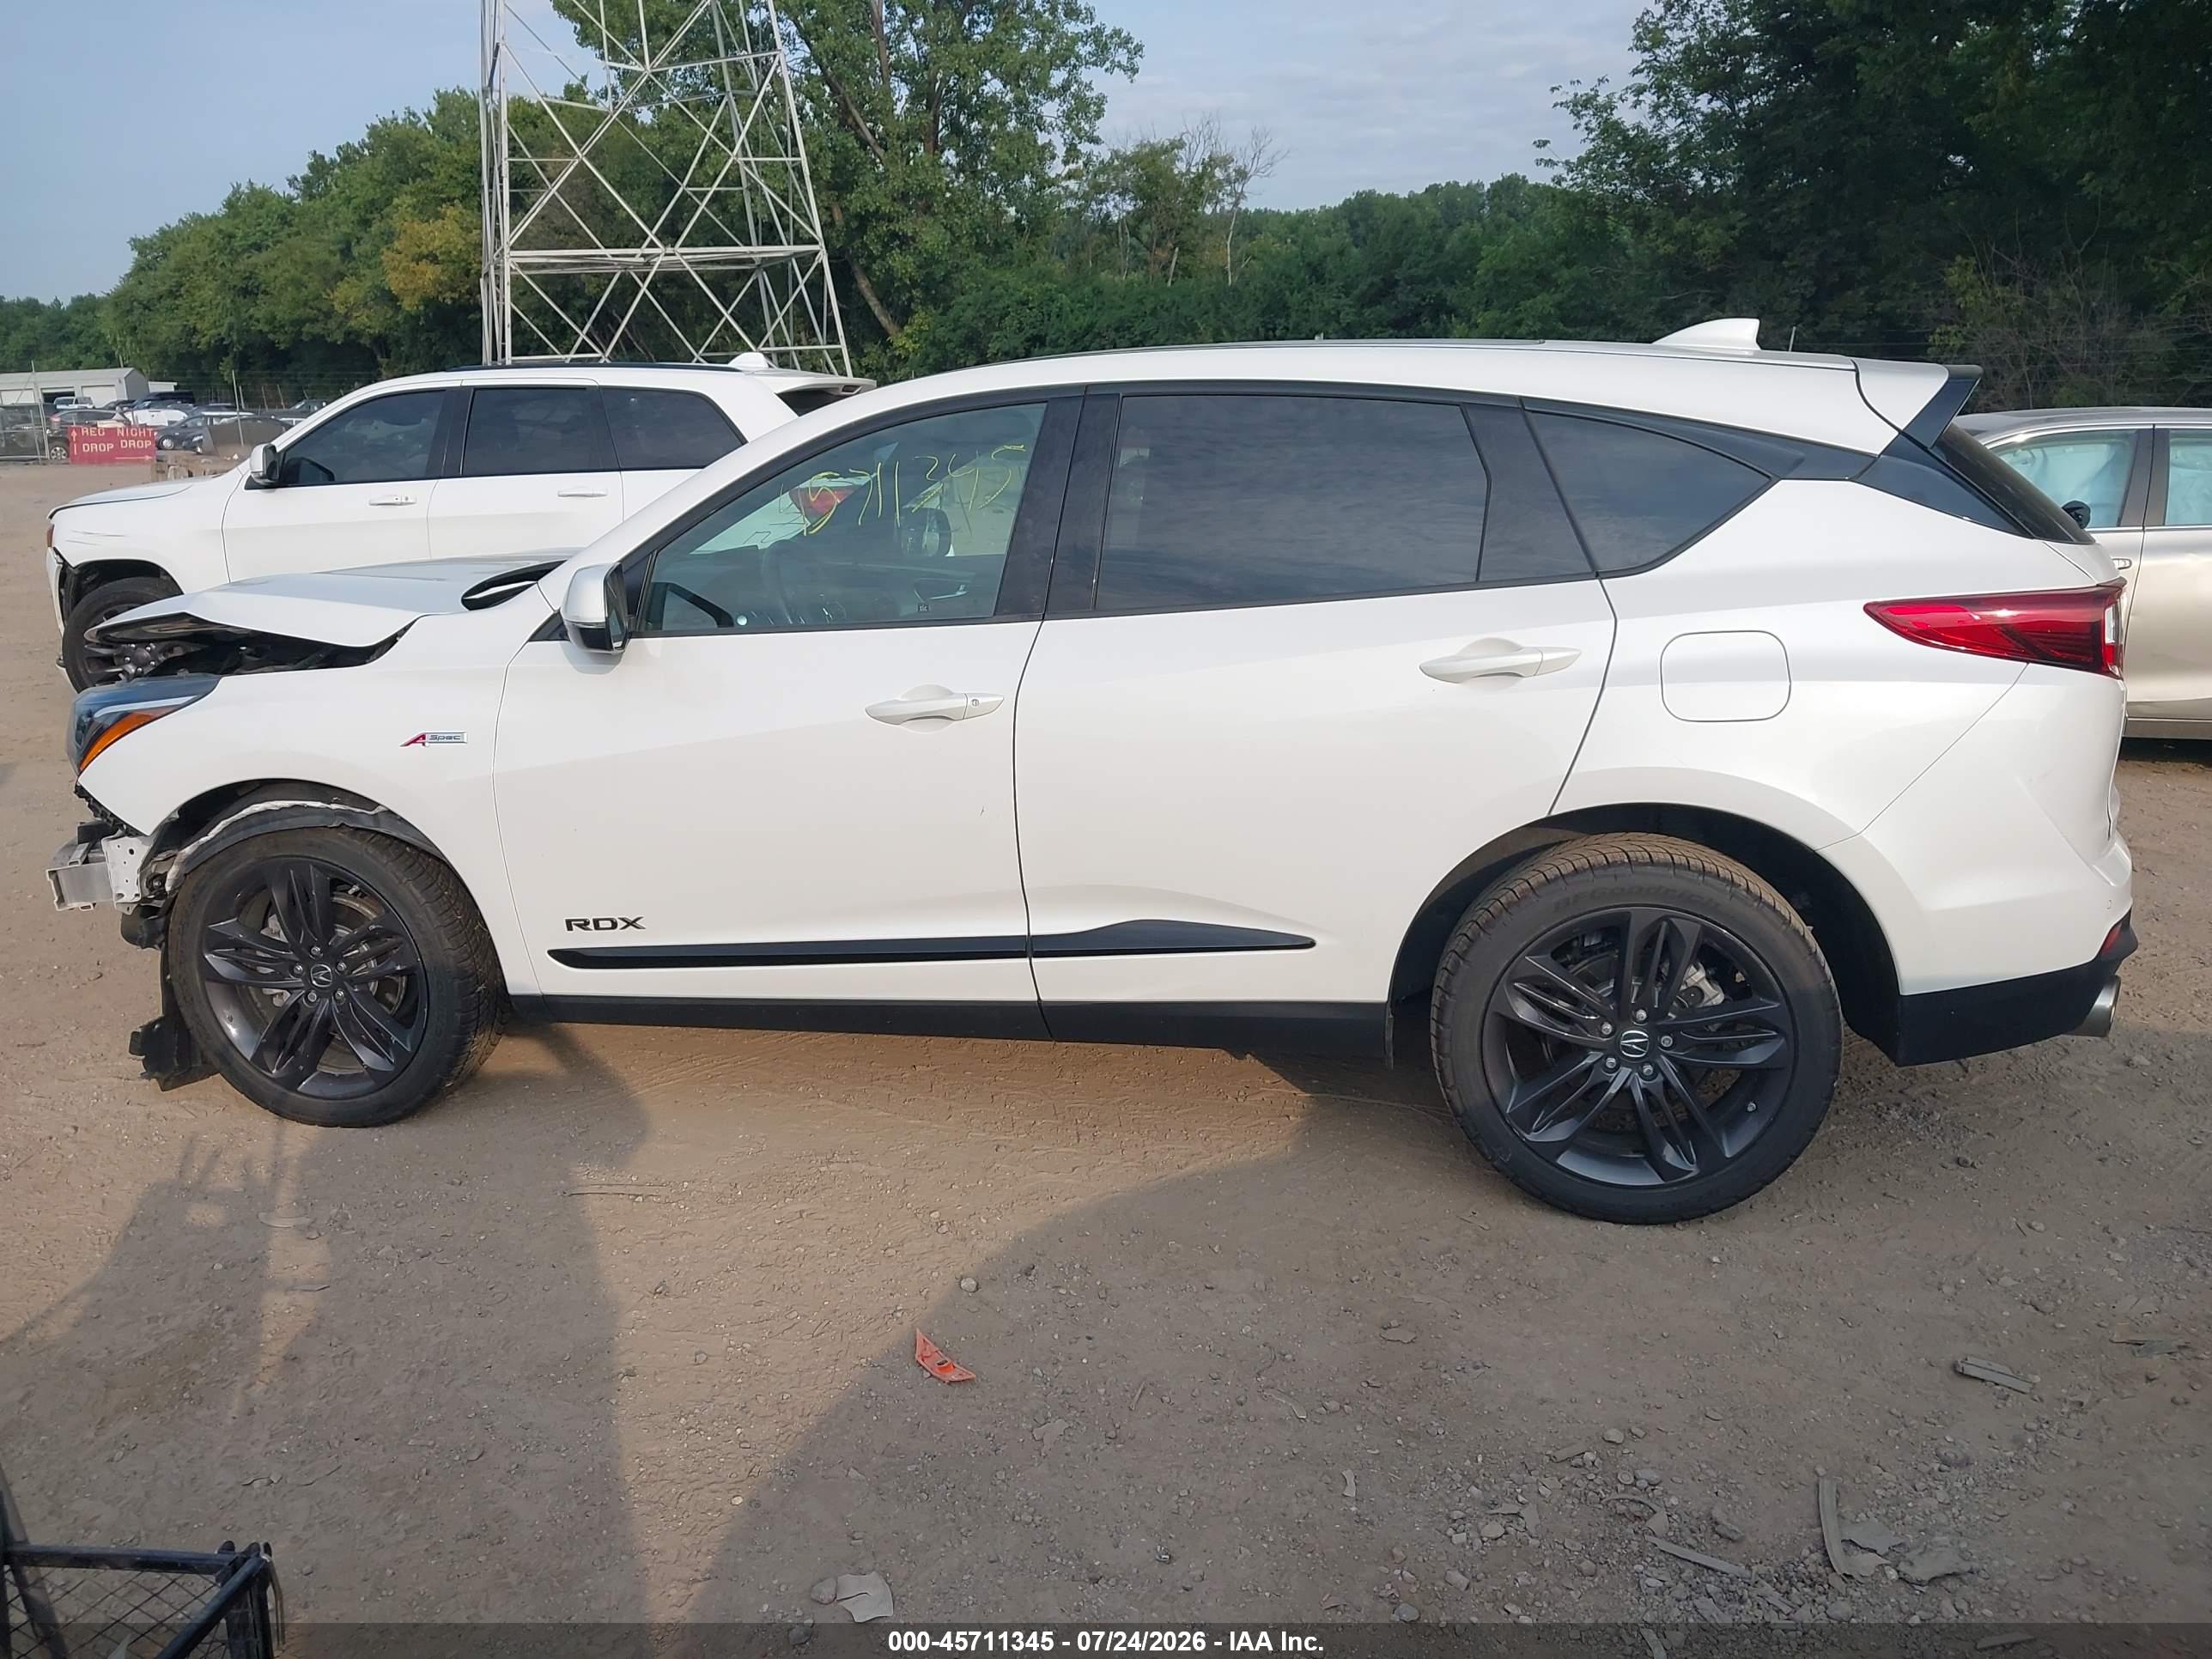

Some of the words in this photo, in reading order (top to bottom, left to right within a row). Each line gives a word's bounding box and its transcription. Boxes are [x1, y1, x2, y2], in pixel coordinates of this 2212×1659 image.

[117, 428, 153, 437] NIGHT
[82, 442, 113, 453] DROP
[120, 439, 151, 448] DROP
[565, 916, 647, 932] RDX
